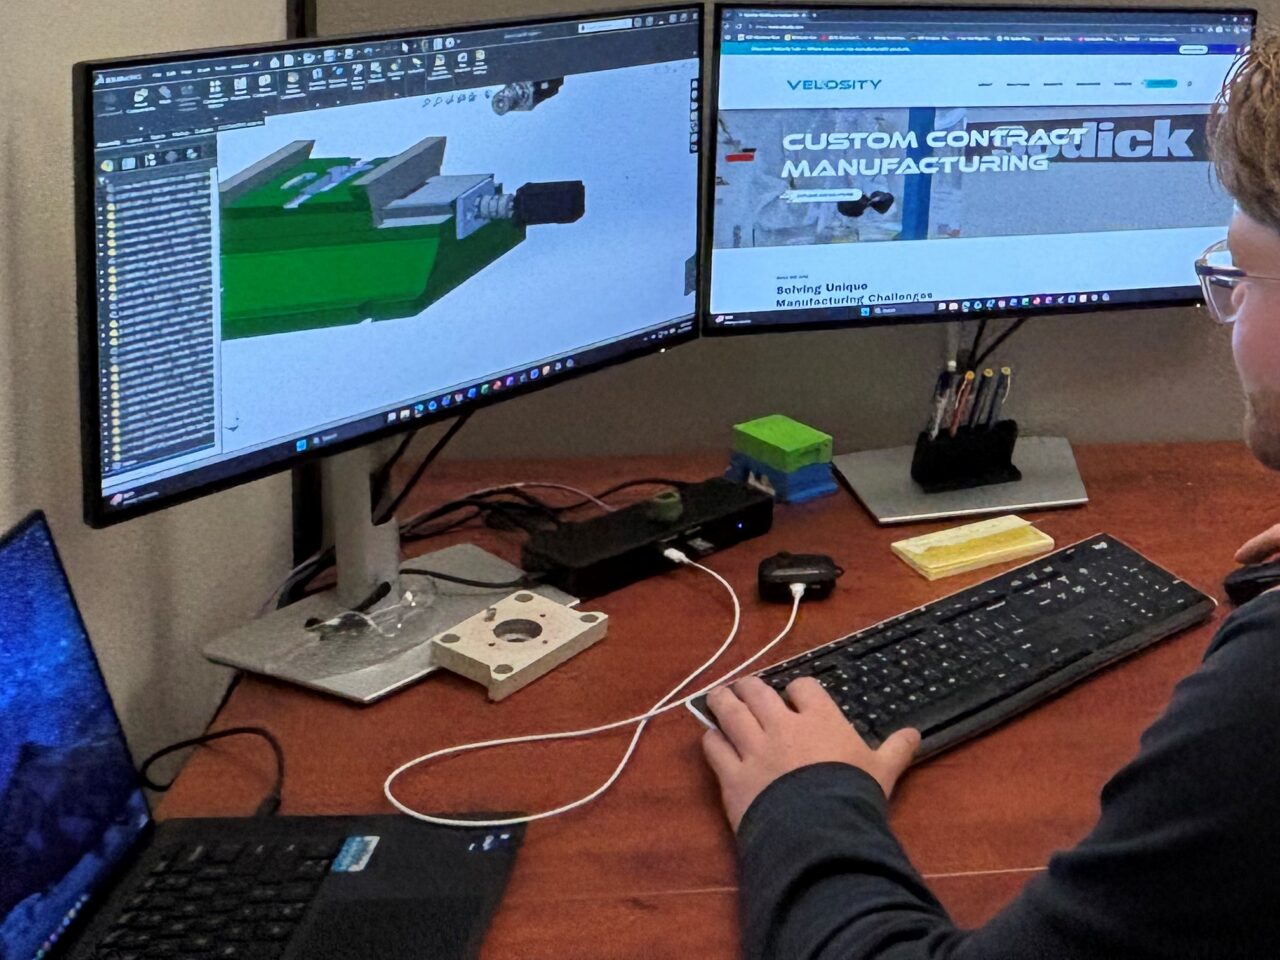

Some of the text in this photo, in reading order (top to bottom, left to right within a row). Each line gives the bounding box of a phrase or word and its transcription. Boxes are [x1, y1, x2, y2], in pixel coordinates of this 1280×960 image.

[786, 79, 882, 91] VELOSITY
[782, 127, 1090, 151] CUSTOM CONTRACT
[780, 154, 1050, 178] MANUFACTURING
